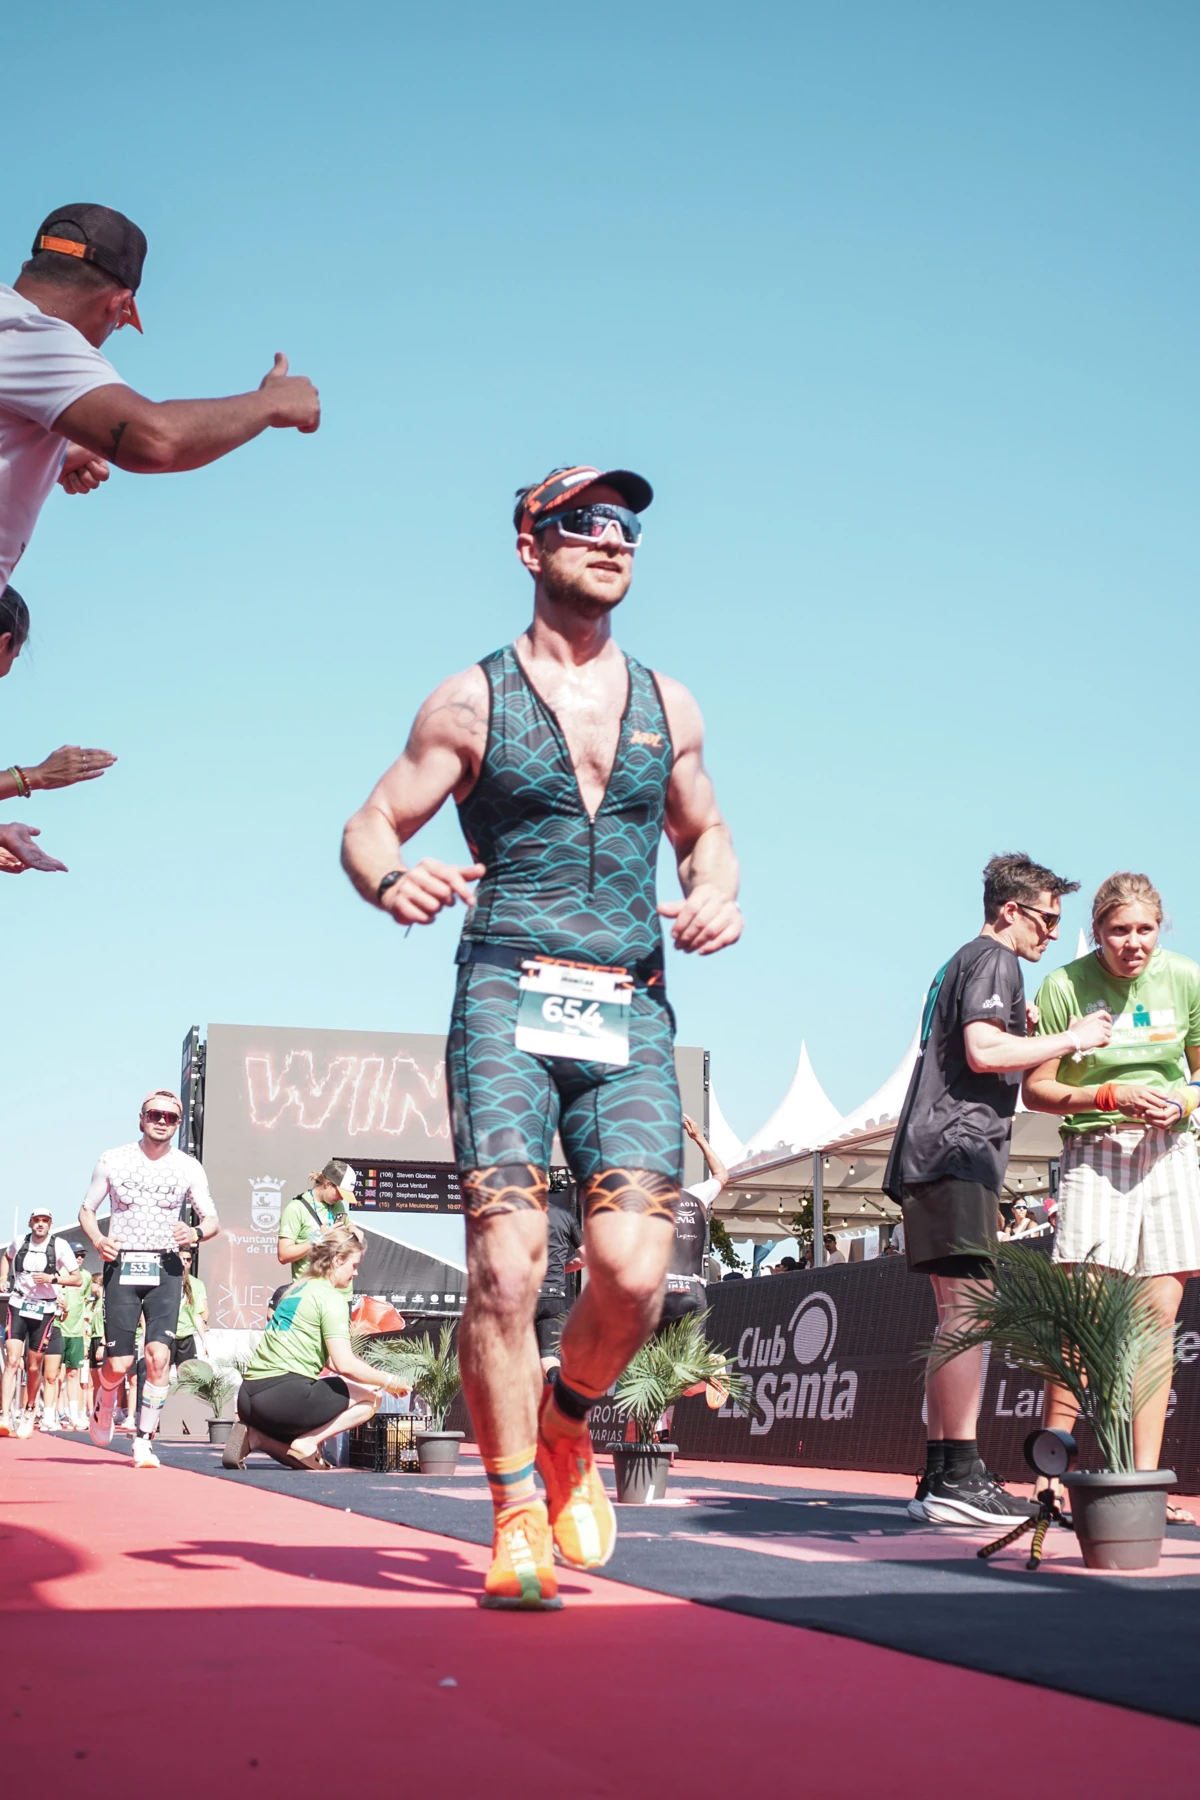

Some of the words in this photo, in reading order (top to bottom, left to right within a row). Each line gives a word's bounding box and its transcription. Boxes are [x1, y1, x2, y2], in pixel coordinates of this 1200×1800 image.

[542, 996, 604, 1028] 654
[408, 1202, 439, 1210] Meulenberg
[228, 1234, 278, 1245] Ayuntami
[246, 1244, 260, 1253] de
[130, 1262, 150, 1272] 533
[737, 1324, 786, 1368] Club
